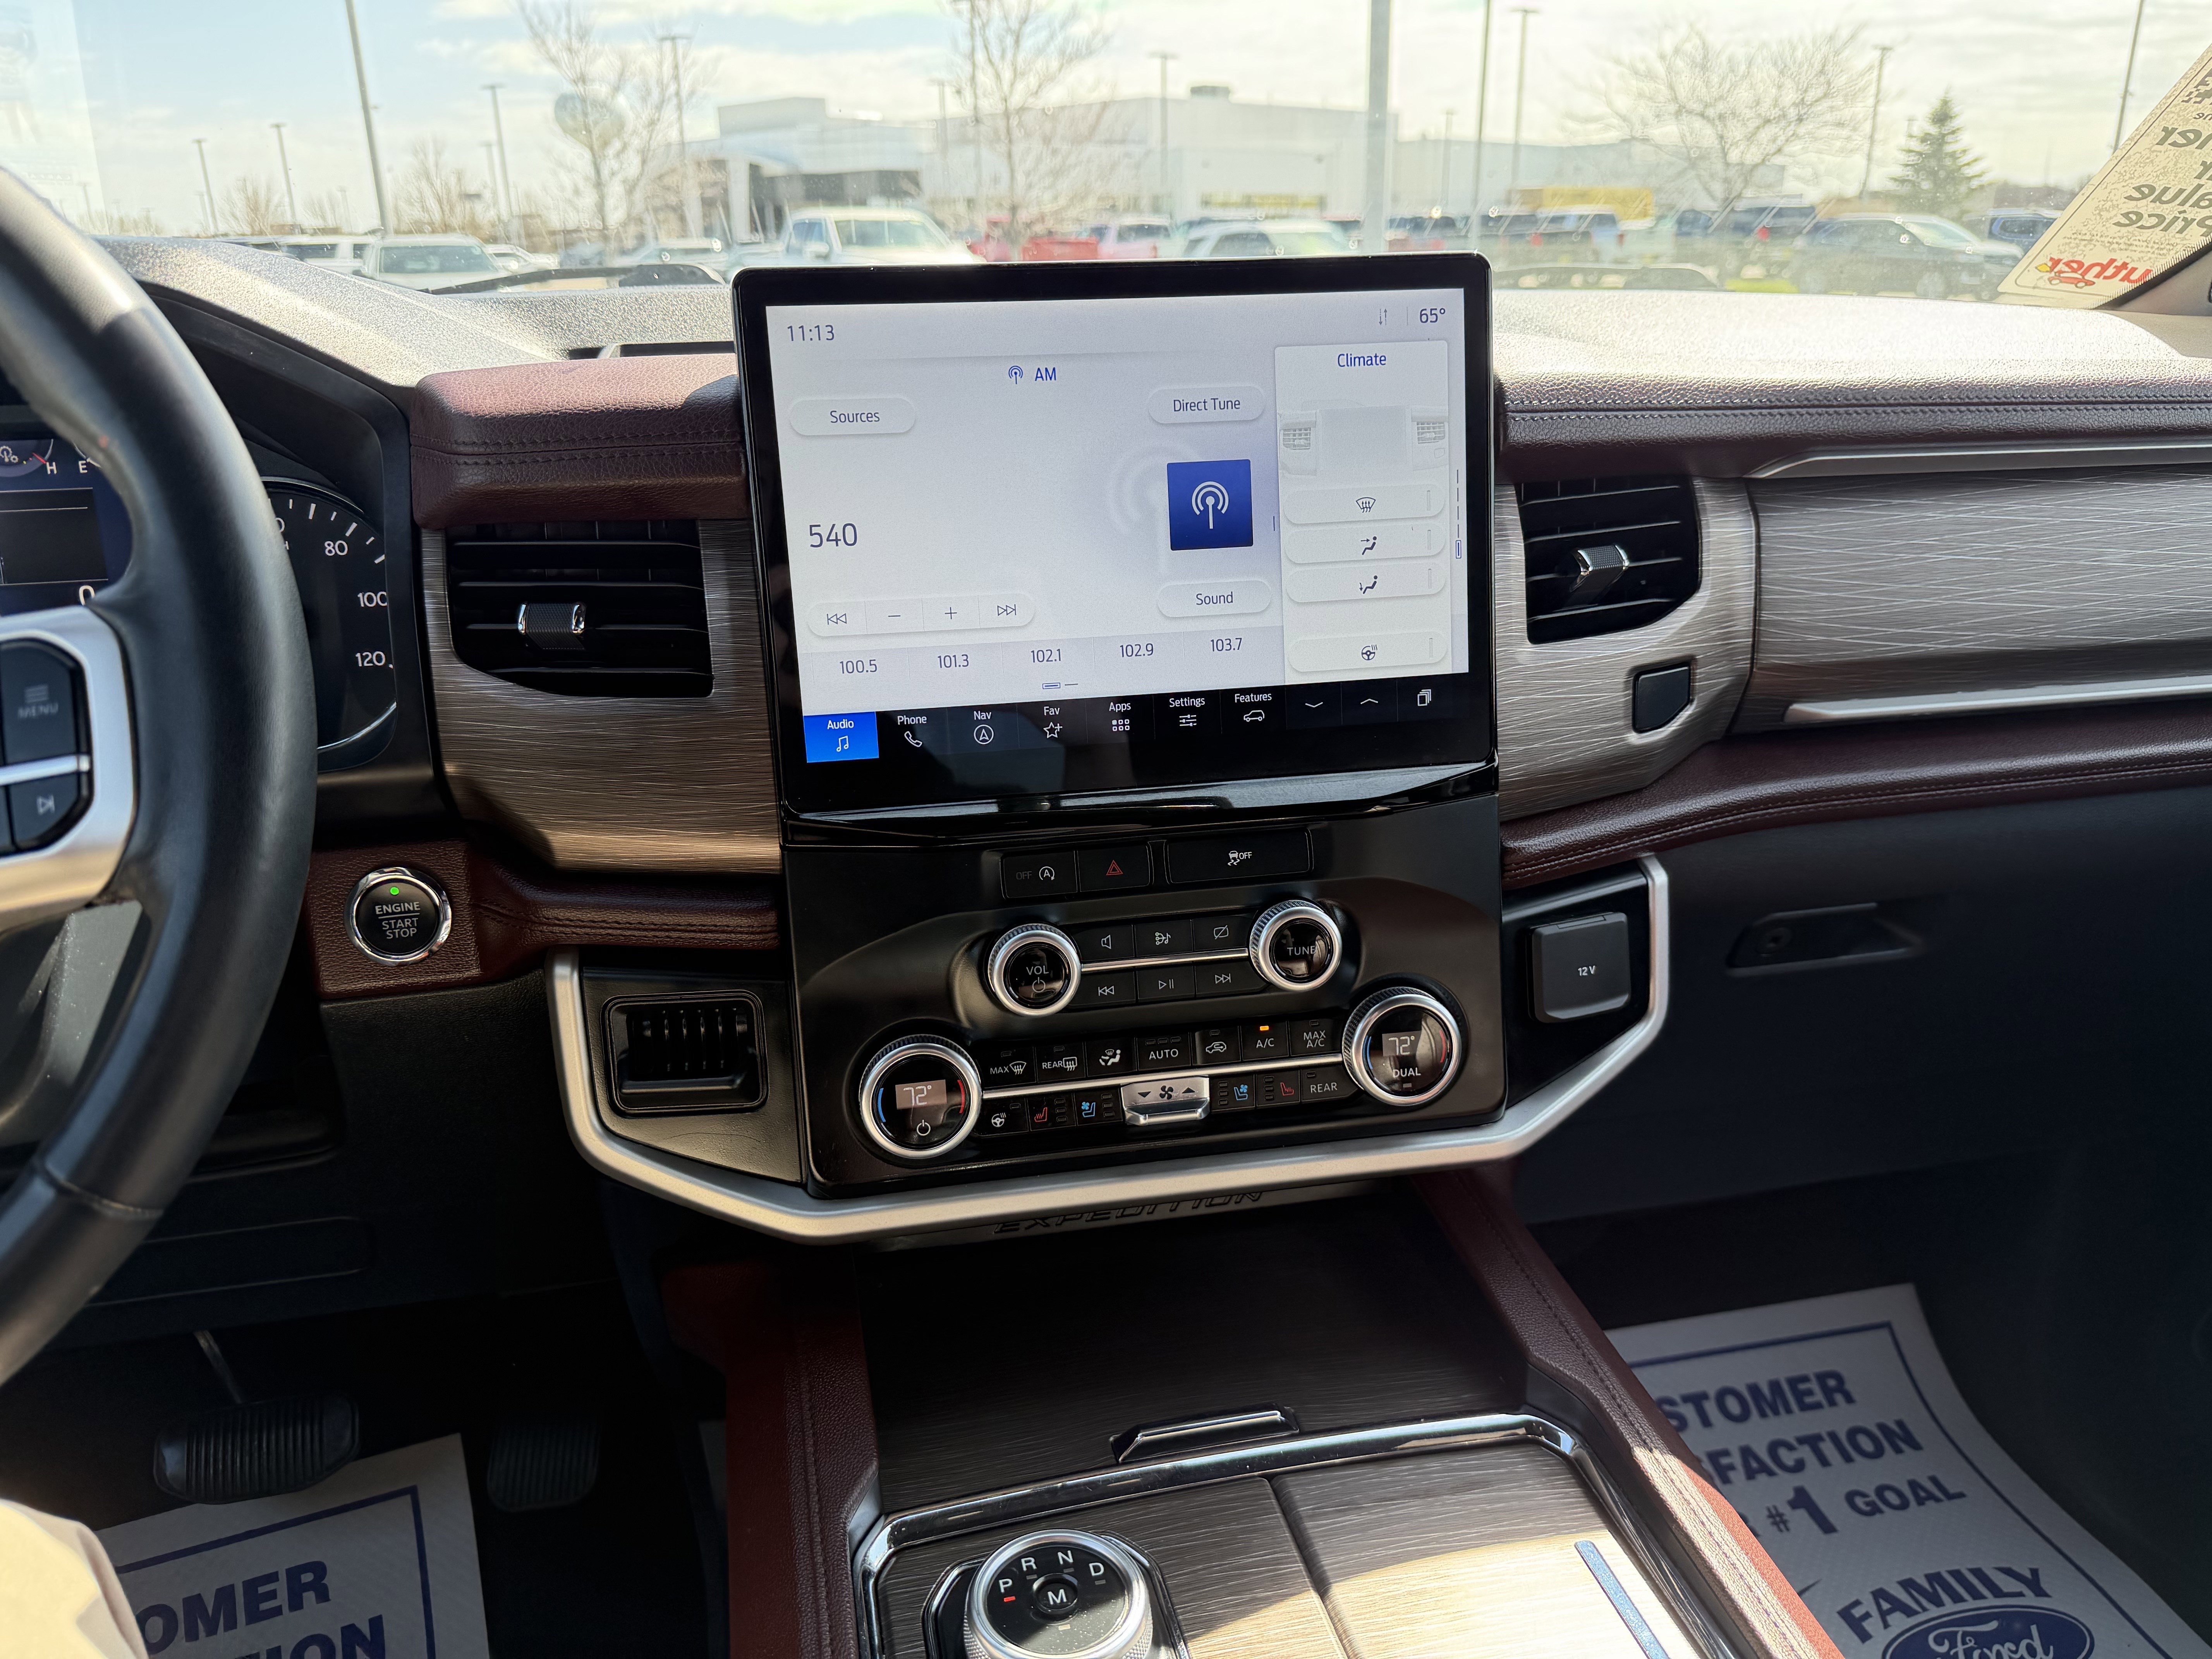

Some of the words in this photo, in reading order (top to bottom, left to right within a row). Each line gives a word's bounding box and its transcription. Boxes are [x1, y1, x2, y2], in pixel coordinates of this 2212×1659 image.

[1419, 307, 1446, 324] 65°
[787, 324, 835, 342] 11:13
[1337, 353, 1387, 368] Climate
[1034, 367, 1057, 381] AM
[1173, 398, 1208, 412] Direct
[1211, 397, 1240, 410] Tune
[830, 410, 880, 424] Sources
[46, 462, 57, 474] H
[79, 461, 88, 473] E
[809, 523, 858, 548] 540
[324, 540, 348, 556] 80
[357, 592, 387, 608] 100
[1195, 591, 1233, 606] Sound
[356, 651, 386, 667] 120
[839, 659, 878, 675] 100.5
[937, 654, 969, 669] 101.3
[1030, 648, 1062, 663] 102.1
[1119, 643, 1154, 658] 102.9
[1210, 637, 1243, 653] 103.7
[827, 718, 854, 730] Audio
[897, 714, 927, 726] Phone
[974, 710, 991, 720] Nav
[1044, 706, 1060, 716] Fav
[1109, 701, 1131, 713] Apps
[1169, 696, 1205, 709] Settings
[1234, 692, 1272, 703] Features
[1239, 852, 1252, 860] OFF
[1016, 871, 1032, 880] OFF
[375, 902, 421, 915] ENGINE
[382, 918, 418, 930] START
[386, 928, 417, 939] STOP
[1287, 946, 1316, 956] TUNE
[1026, 965, 1049, 975] VOL
[1304, 1030, 1326, 1041] MAX
[1256, 1038, 1274, 1048] A/C
[1307, 1039, 1325, 1048] A/C
[1149, 1049, 1178, 1060] AUTO
[990, 1066, 1009, 1075] MAX
[1042, 1061, 1063, 1069] REAR
[1393, 1067, 1421, 1077] DUAL
[1310, 1082, 1338, 1093] REAR
[1696, 1419, 1923, 1486] FACTION
[1766, 1485, 1838, 1536] #1
[1843, 1474, 1967, 1517] GOAL
[1021, 1557, 1037, 1571] R
[1057, 1550, 1074, 1565] N
[1089, 1562, 1105, 1577] D
[999, 1578, 1013, 1593] P
[1047, 1589, 1067, 1605] M
[1836, 1566, 2053, 1644] FAMILY
